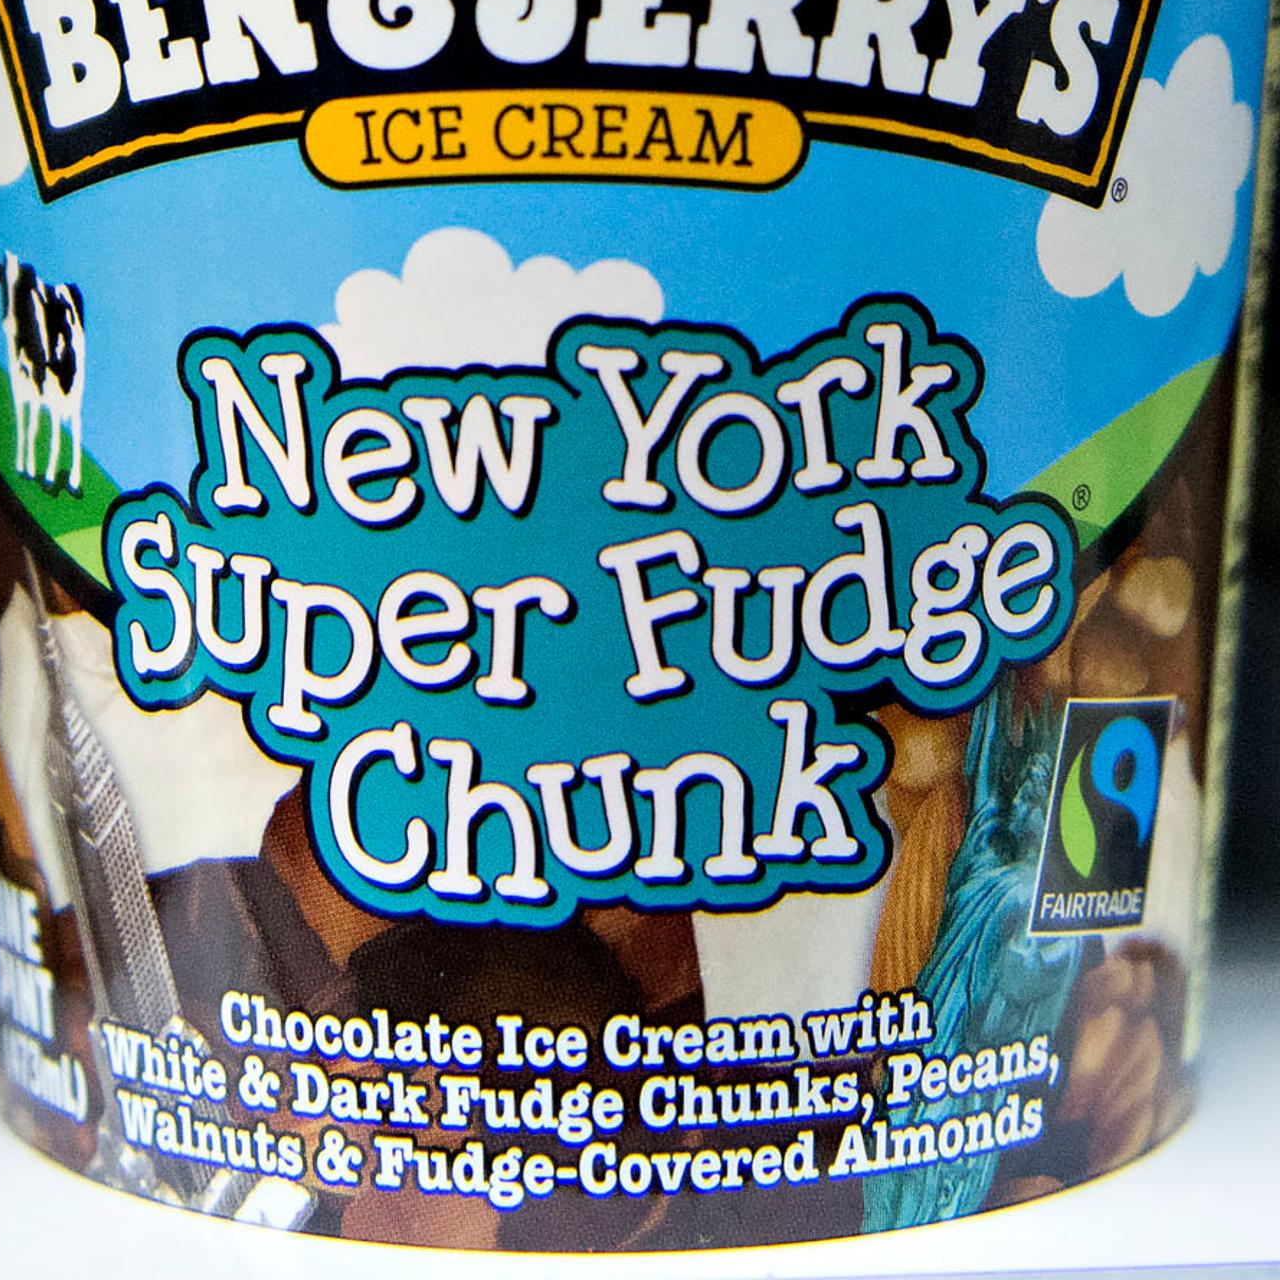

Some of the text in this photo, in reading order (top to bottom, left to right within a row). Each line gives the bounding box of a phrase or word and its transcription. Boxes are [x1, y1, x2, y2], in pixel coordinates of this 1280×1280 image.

[354, 103, 755, 168] ICE CREAM
[199, 322, 956, 525] New York
[119, 501, 1055, 735] Super Fudge
[327, 698, 861, 902] Chunk
[1039, 887, 1145, 920] FAIRTRADE
[101, 1022, 228, 1101] White
[239, 1055, 282, 1112] &
[290, 1062, 430, 1127] Dark
[440, 1072, 624, 1143] Fudge
[639, 1067, 874, 1129] Chunks,
[887, 1035, 1061, 1105] Pecans,
[220, 989, 933, 1070] Chocolate Ice Cream with
[116, 1090, 1043, 1210] Walnuts & Fudge-Covered Almonds
